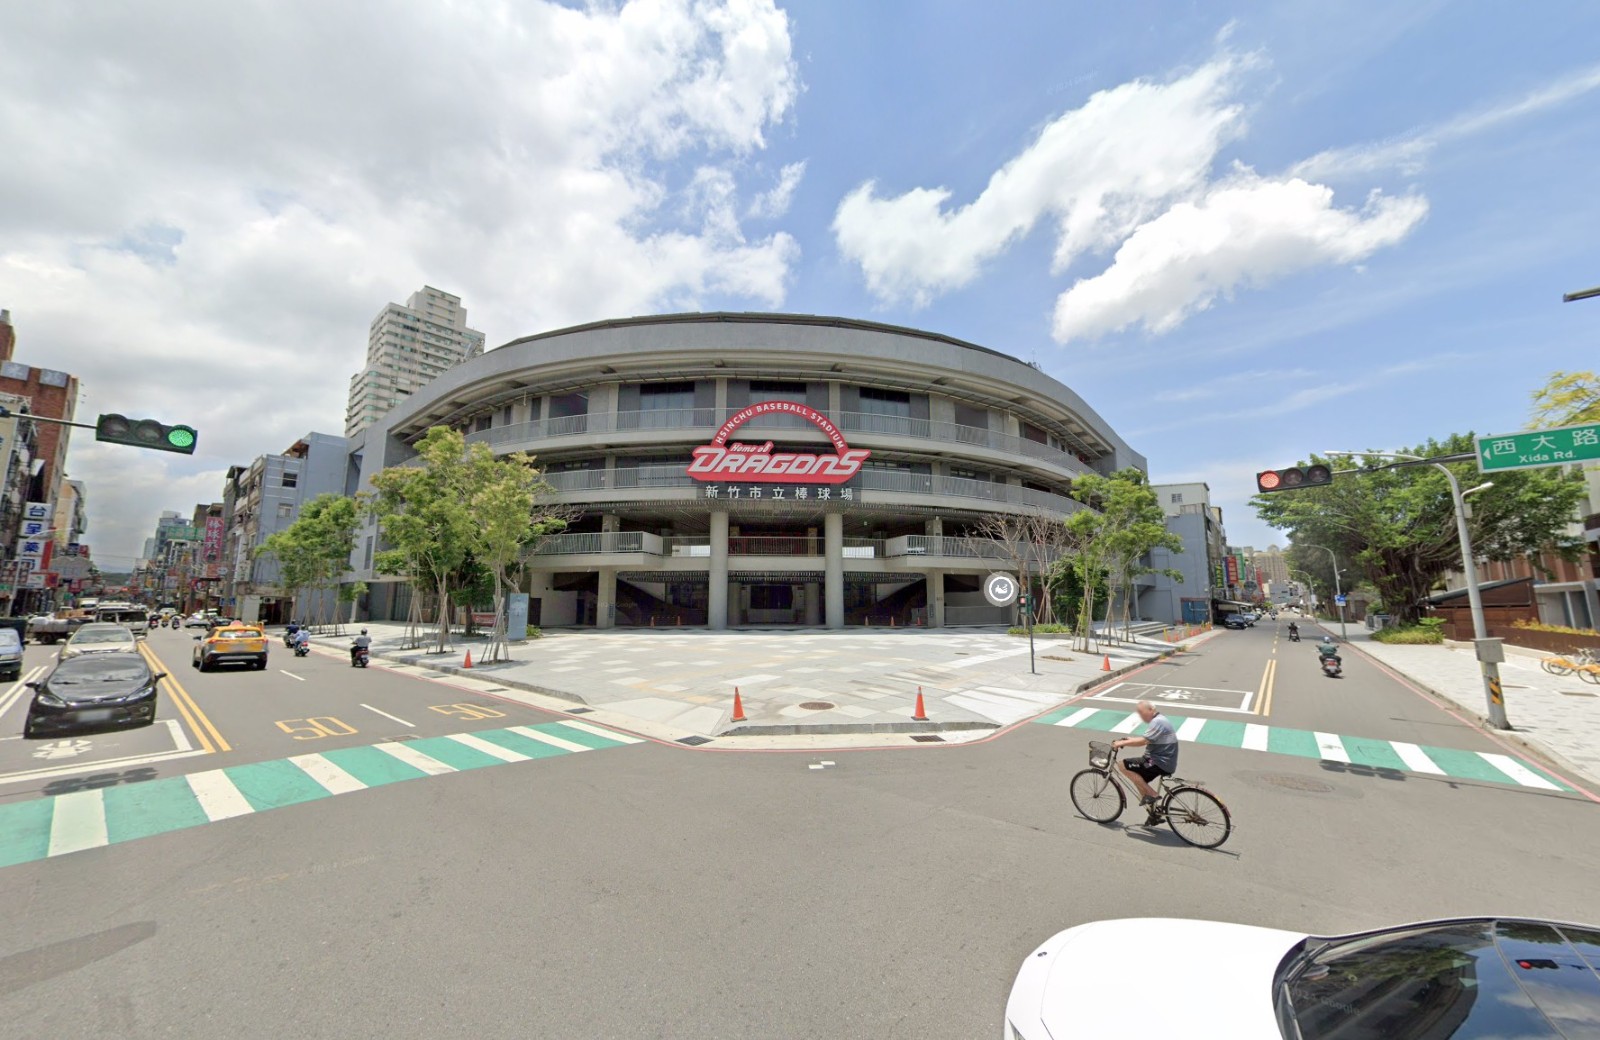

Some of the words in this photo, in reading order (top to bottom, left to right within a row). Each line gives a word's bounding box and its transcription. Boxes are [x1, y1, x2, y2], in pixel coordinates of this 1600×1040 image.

[716, 409, 753, 444] HSINCHU
[756, 402, 808, 416] BASEBALL
[810, 412, 845, 449] STADIUM
[731, 443, 755, 453] Home
[1491, 428, 1599, 455] 西大路
[1519, 454, 1550, 464] Xida
[1553, 450, 1577, 460] Rd.
[705, 485, 854, 500] 新竹市立棒球場
[427, 703, 507, 720] 50
[275, 716, 359, 740] 50
